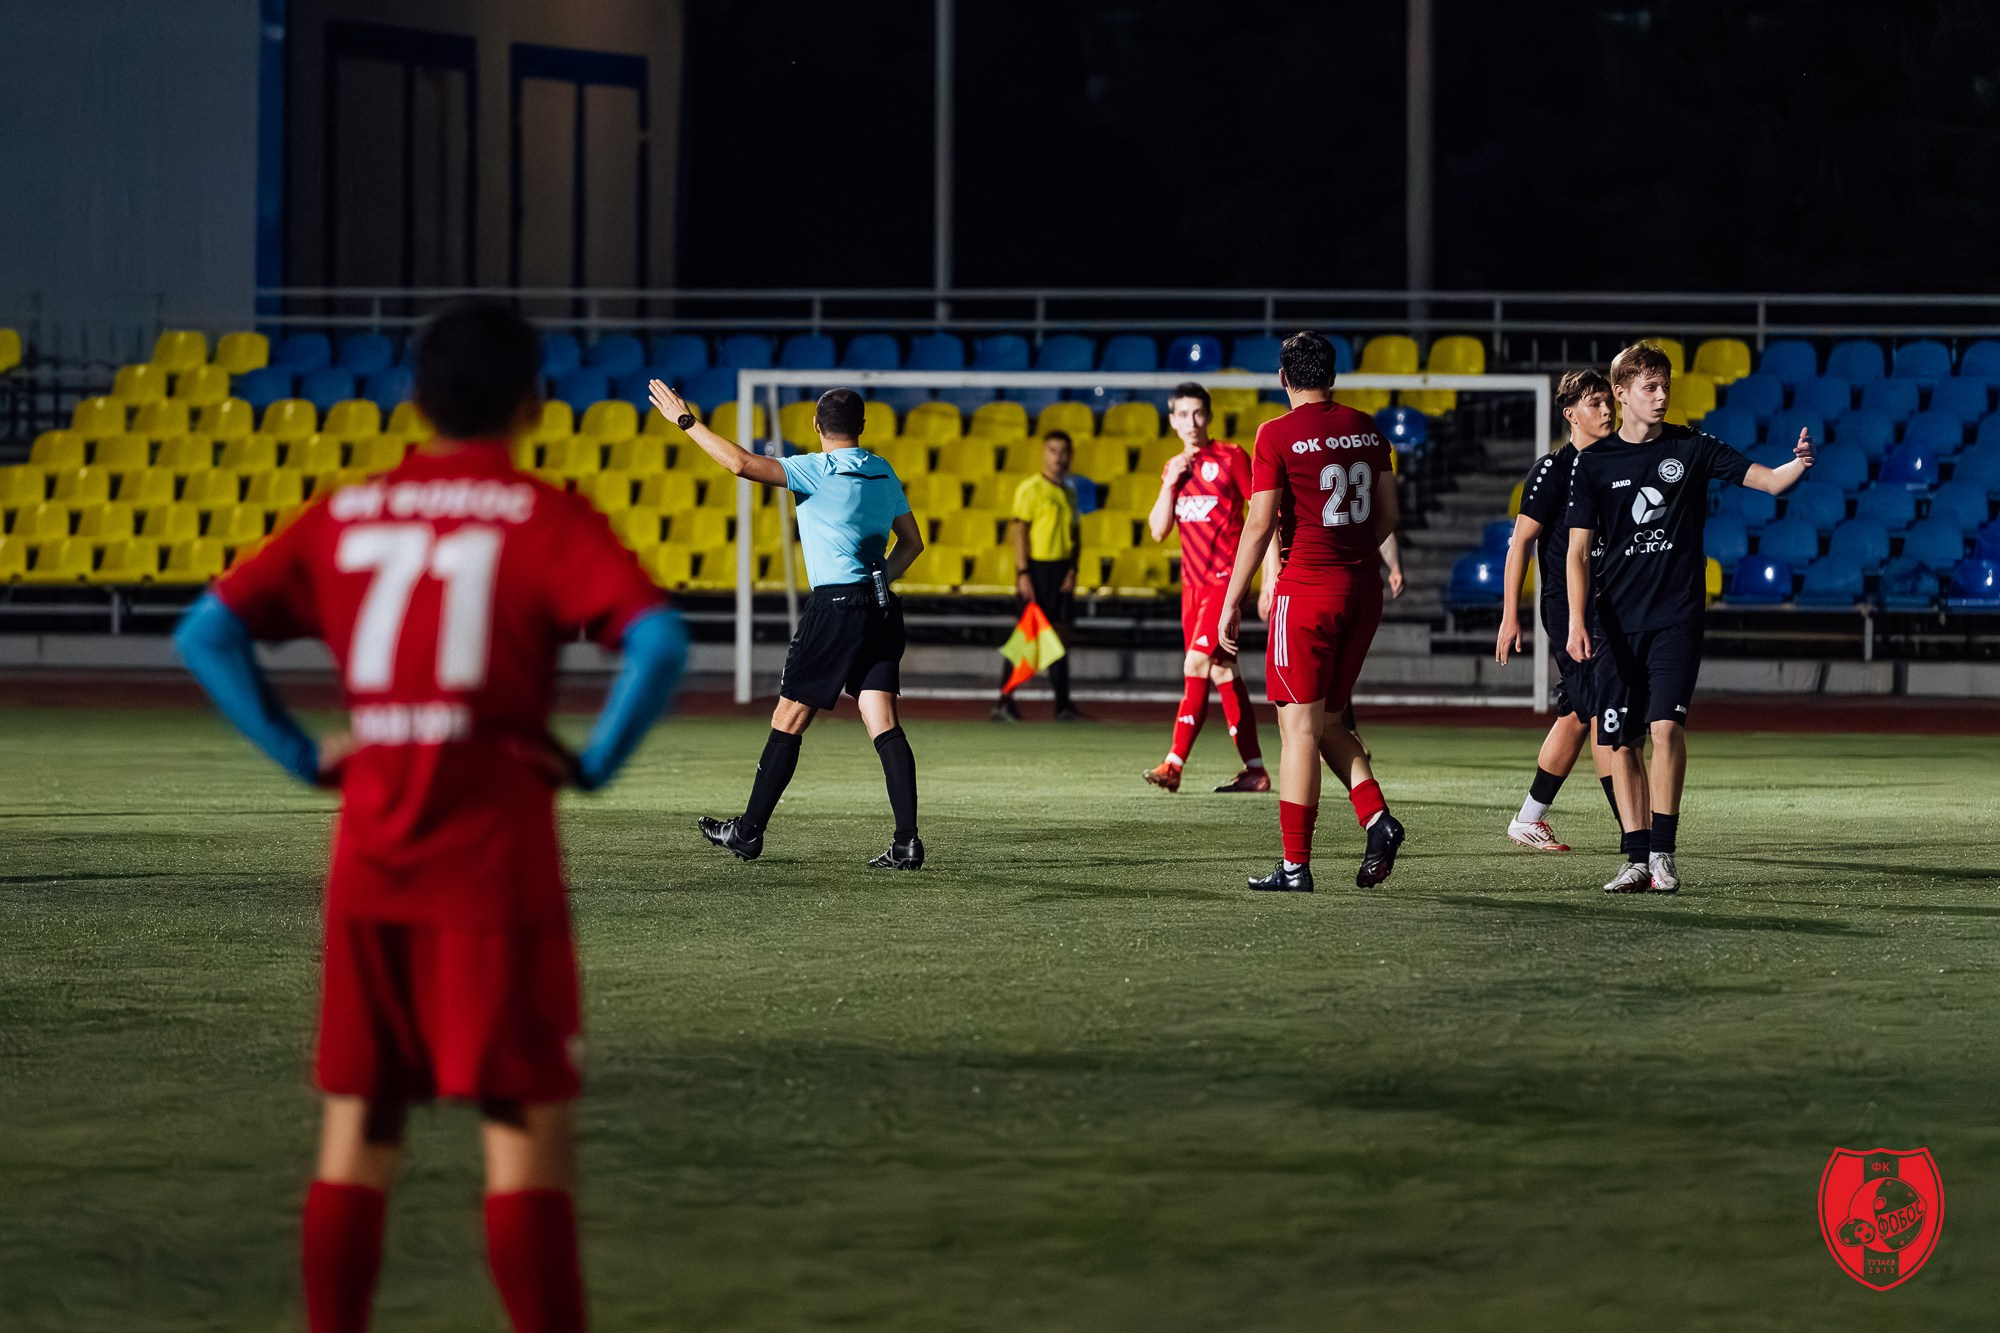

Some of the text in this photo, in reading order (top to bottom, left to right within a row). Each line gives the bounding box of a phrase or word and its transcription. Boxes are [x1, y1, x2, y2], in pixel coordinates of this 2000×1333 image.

[1292, 433, 1379, 454] ФК ФОБОС
[1320, 461, 1371, 526] 23
[1611, 479, 1631, 489] JAKO
[336, 523, 504, 692] 71
